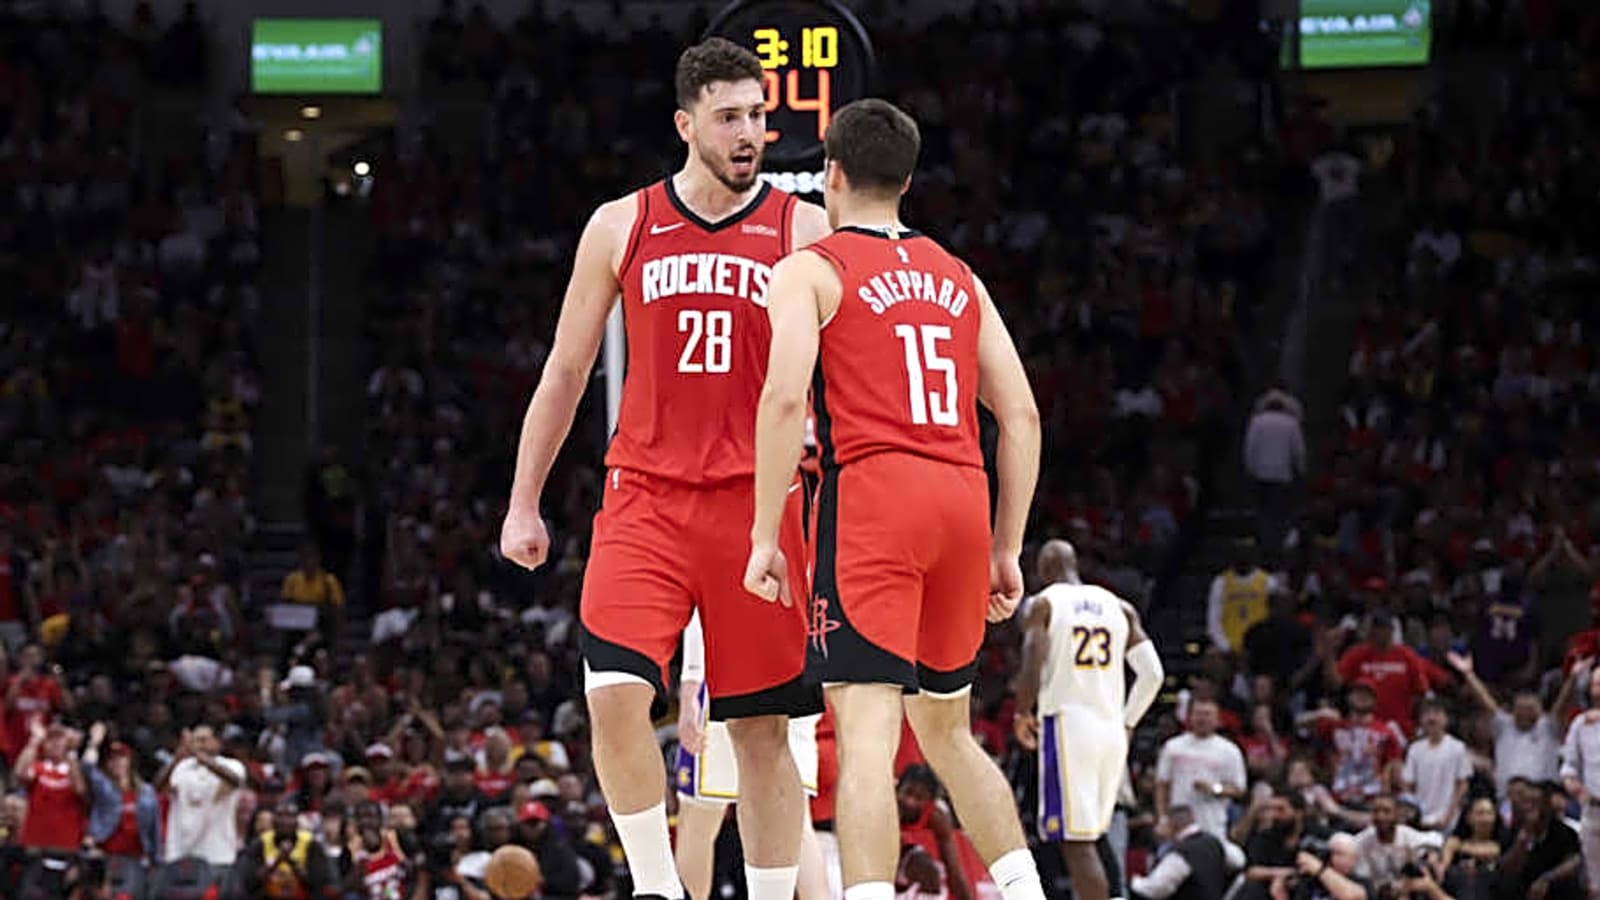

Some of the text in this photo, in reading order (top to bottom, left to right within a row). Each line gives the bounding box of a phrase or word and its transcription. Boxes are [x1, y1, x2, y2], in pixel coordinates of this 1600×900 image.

[754, 27, 838, 69] 3:10
[642, 253, 772, 308] ROCKETS
[858, 270, 969, 318] SHEPPARD
[677, 310, 732, 373] 28
[895, 324, 959, 427] 15
[1072, 625, 1112, 668] 23
